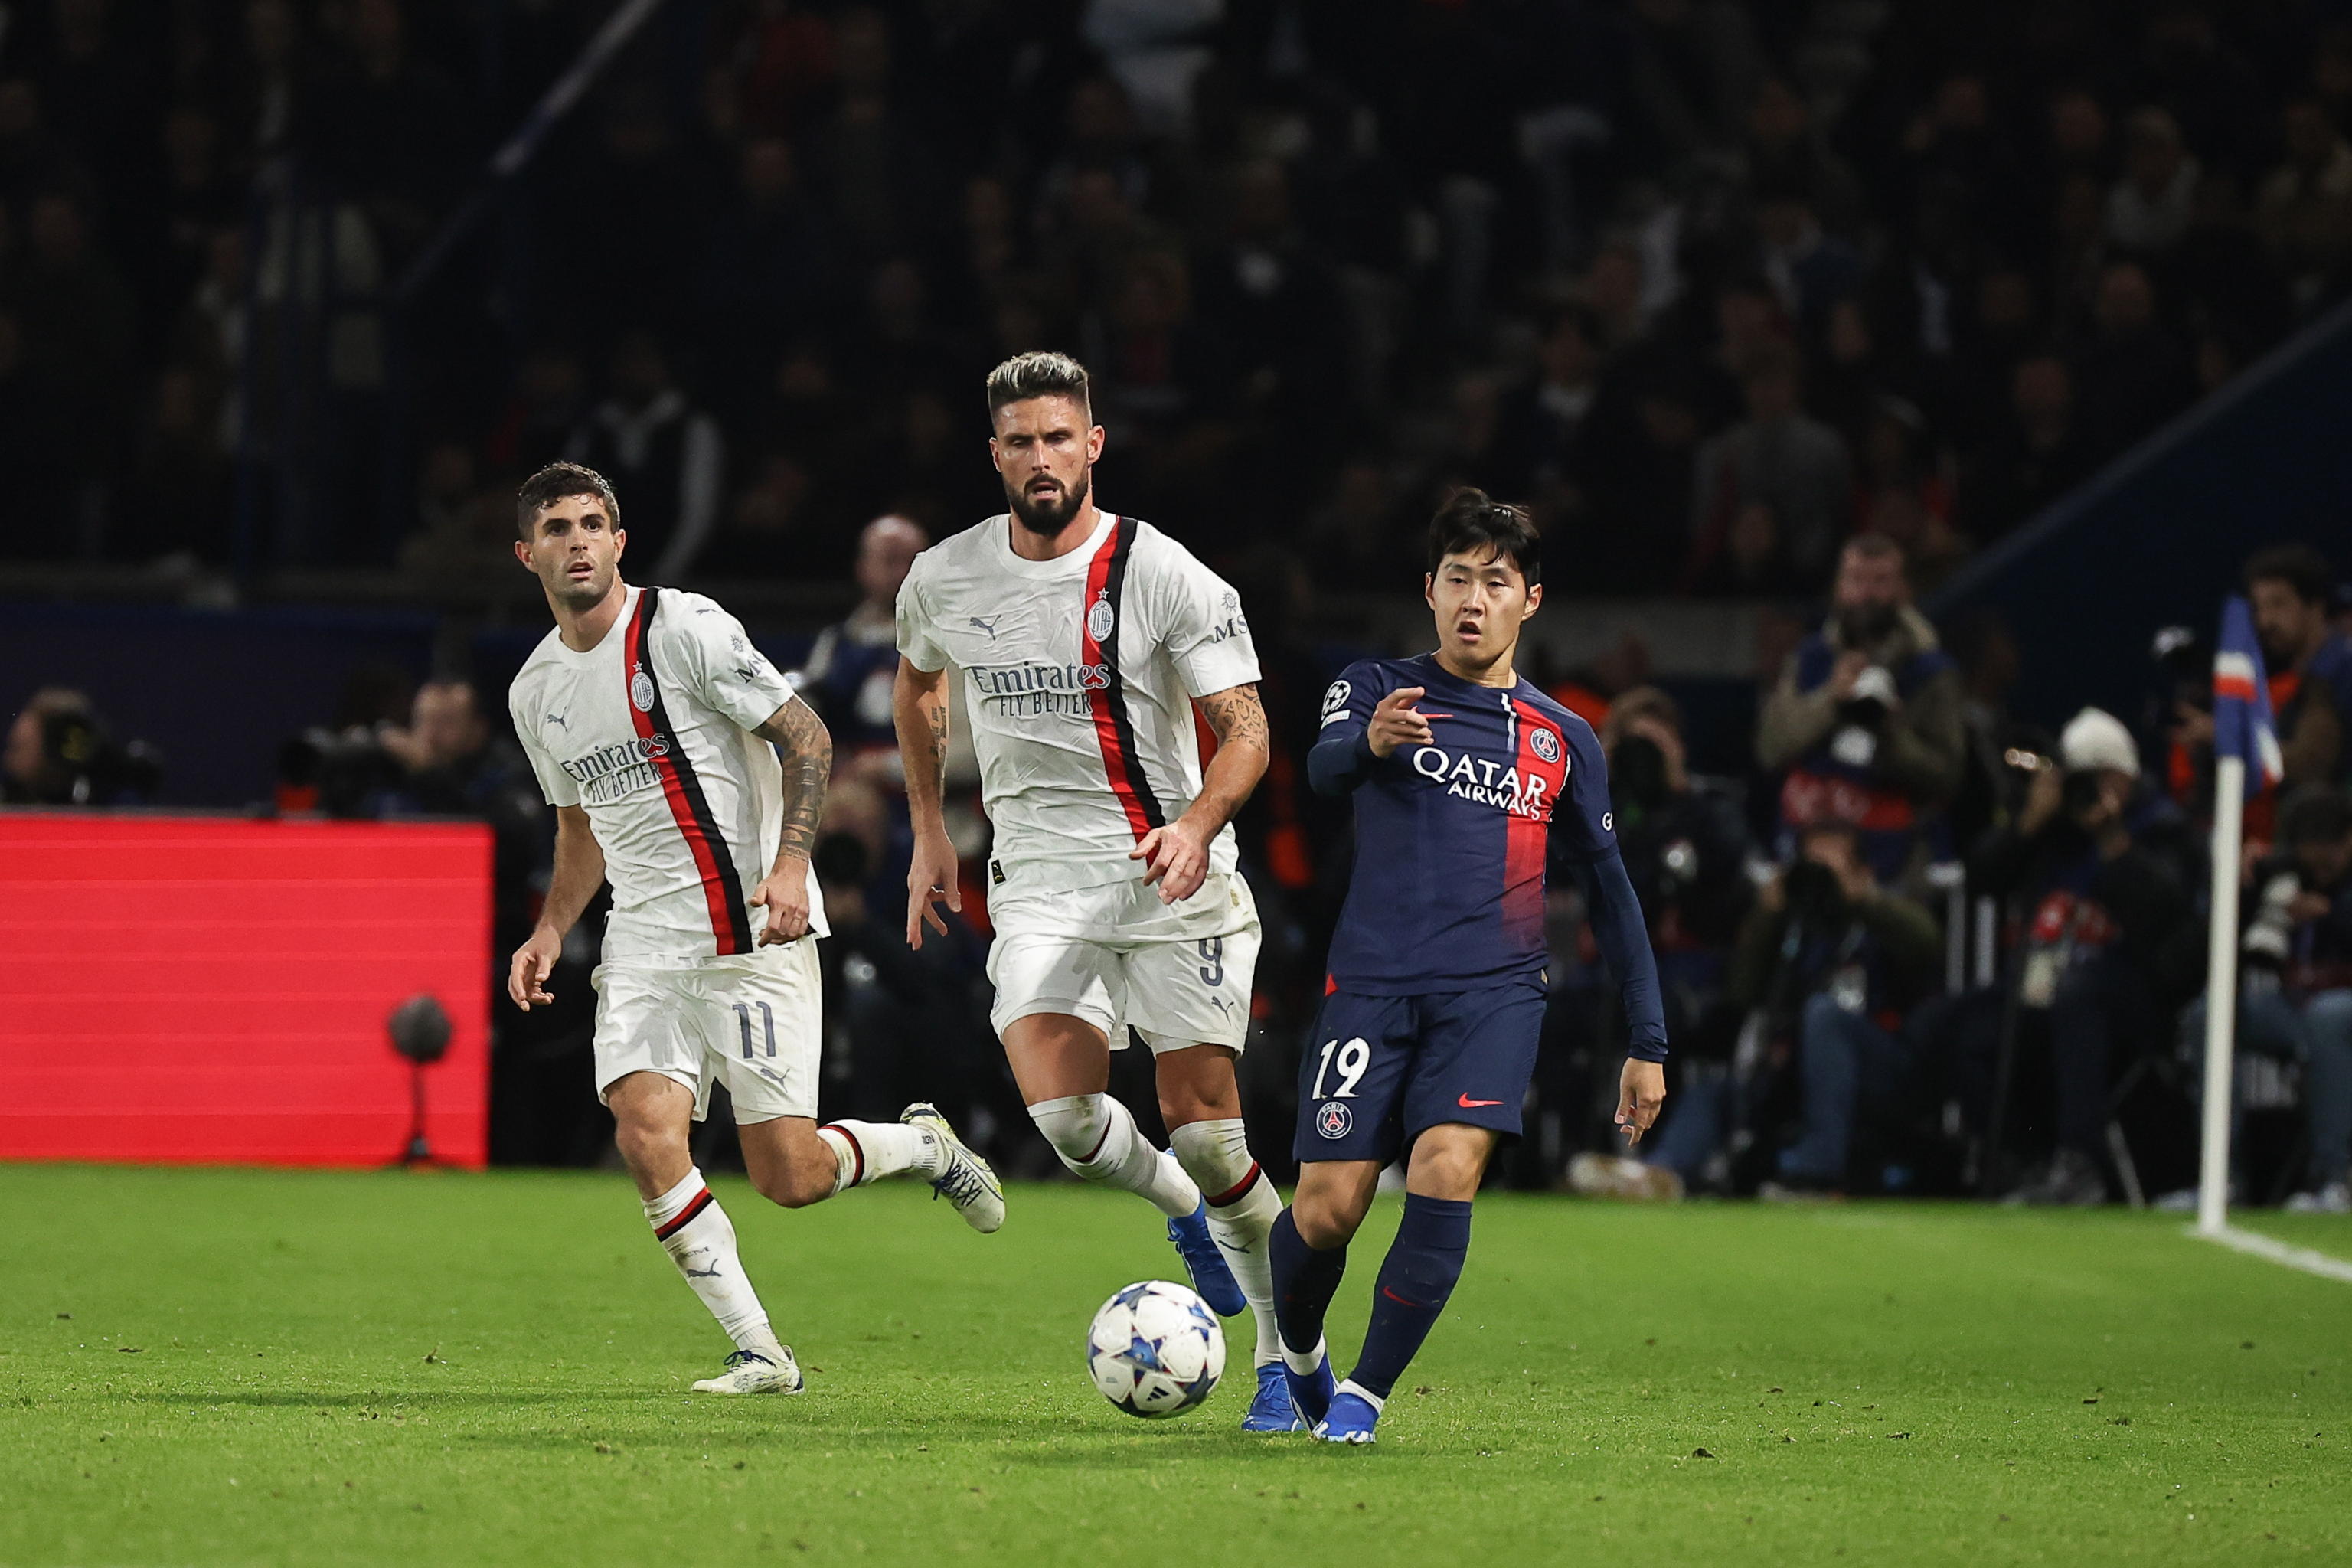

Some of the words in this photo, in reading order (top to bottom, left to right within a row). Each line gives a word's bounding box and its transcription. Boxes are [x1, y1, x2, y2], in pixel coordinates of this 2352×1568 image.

[971, 661, 1111, 694] Emirates
[1000, 694, 1024, 717] FLY
[1034, 691, 1093, 714] BETTER
[560, 733, 670, 782] Emirates
[611, 763, 664, 798] BETTER
[1413, 746, 1547, 807] QATAR
[1447, 780, 1541, 821] AIRWAYS
[1198, 936, 1223, 987] 9
[733, 1001, 776, 1059] 11
[1312, 1037, 1370, 1100] 19
